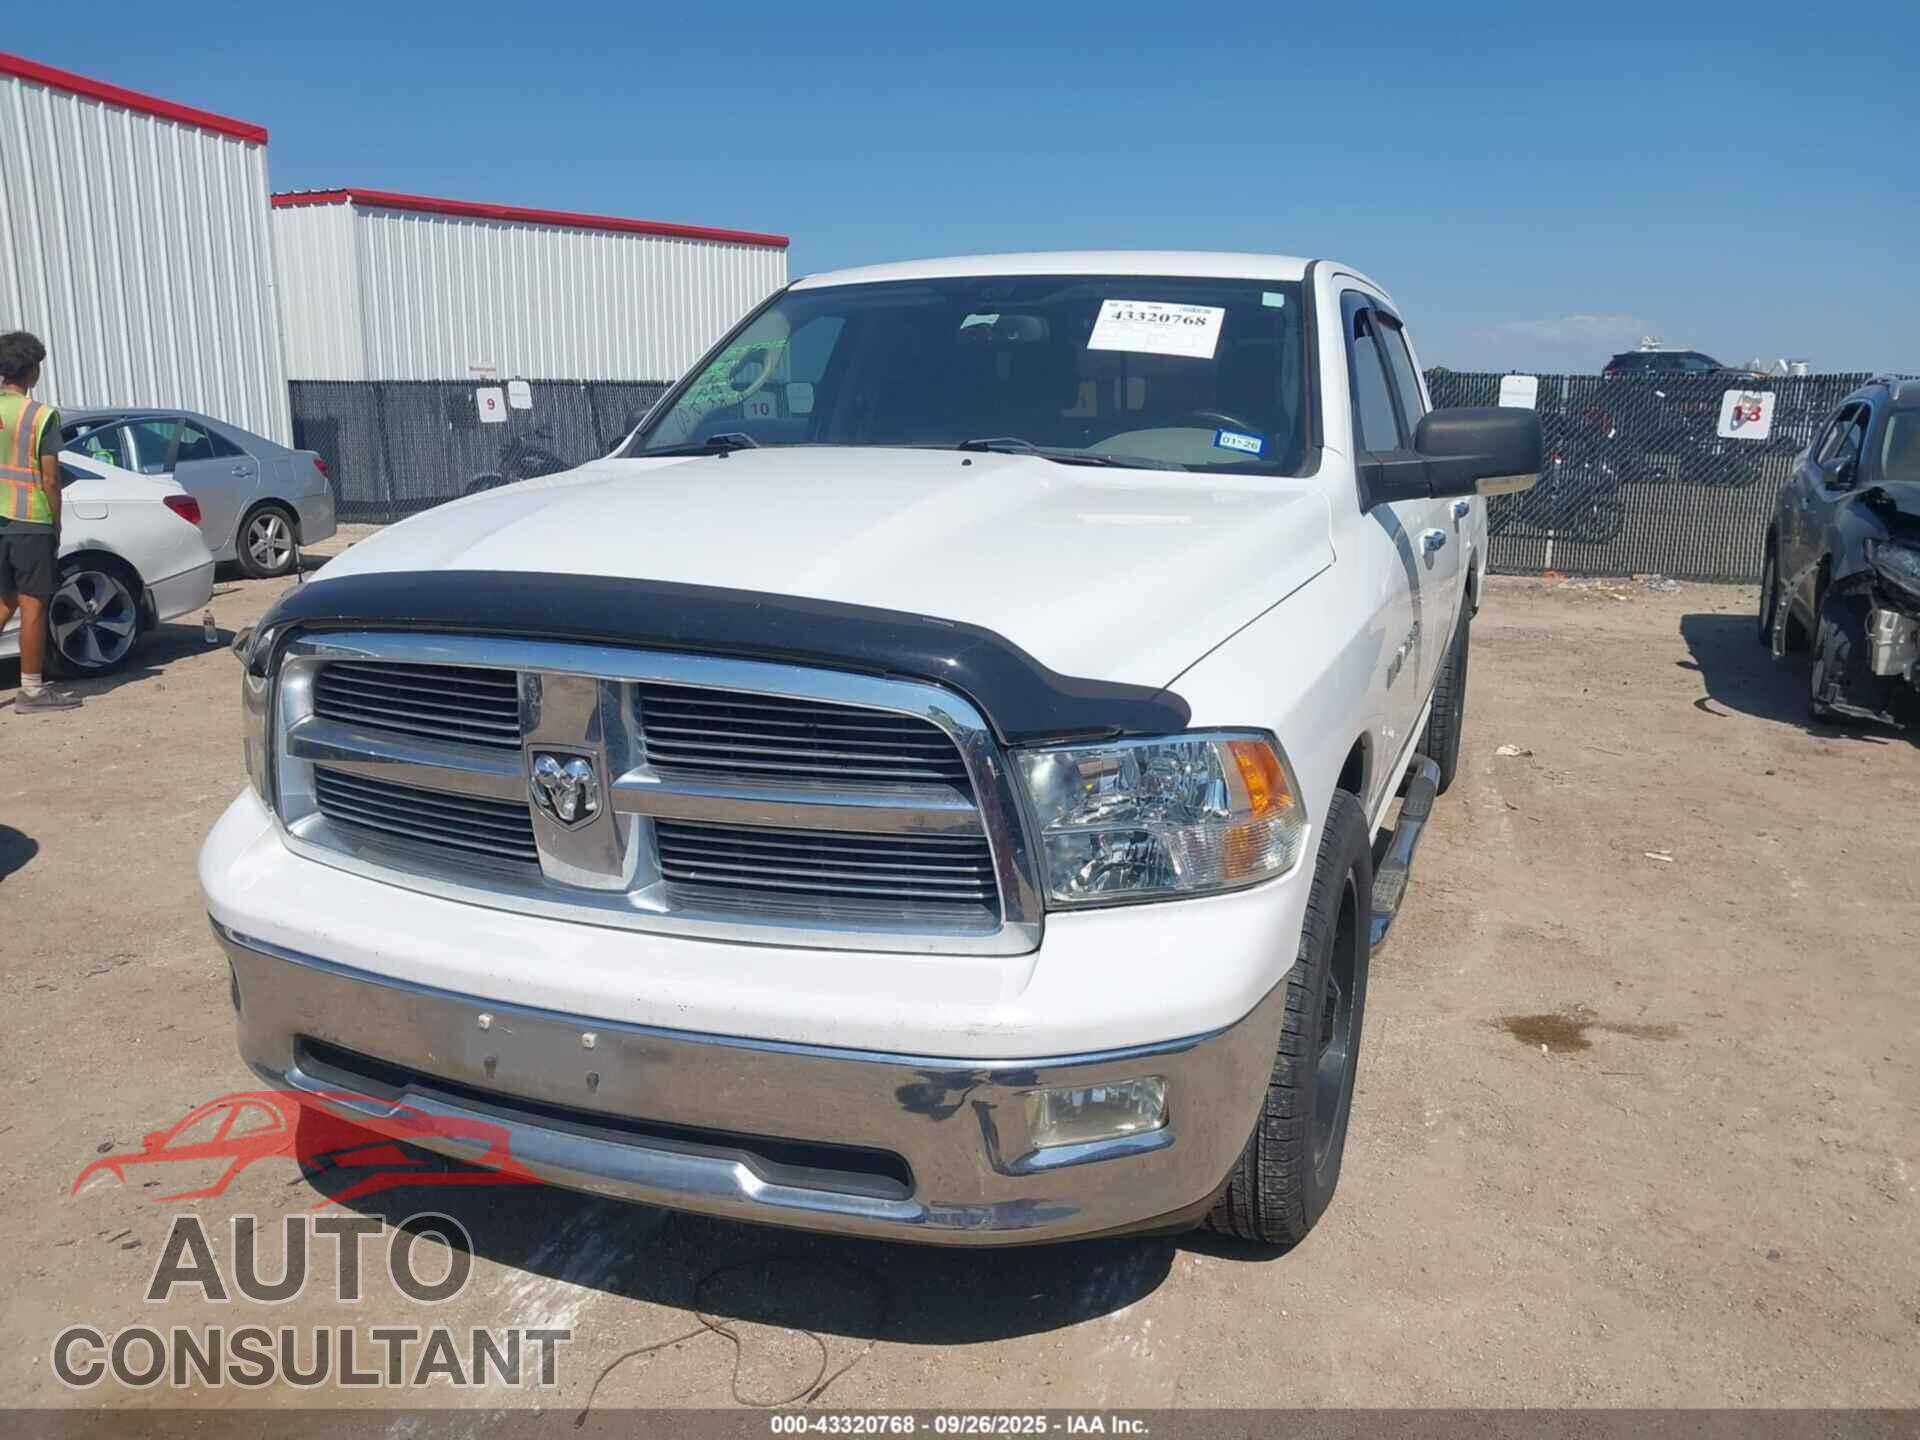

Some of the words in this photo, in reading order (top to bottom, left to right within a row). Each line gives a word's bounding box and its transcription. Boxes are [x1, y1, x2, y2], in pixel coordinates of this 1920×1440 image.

[1111, 310, 1206, 326] 43320768
[487, 398, 496, 410] 9
[751, 402, 769, 416] 10
[1222, 436, 1259, 450] 01-26
